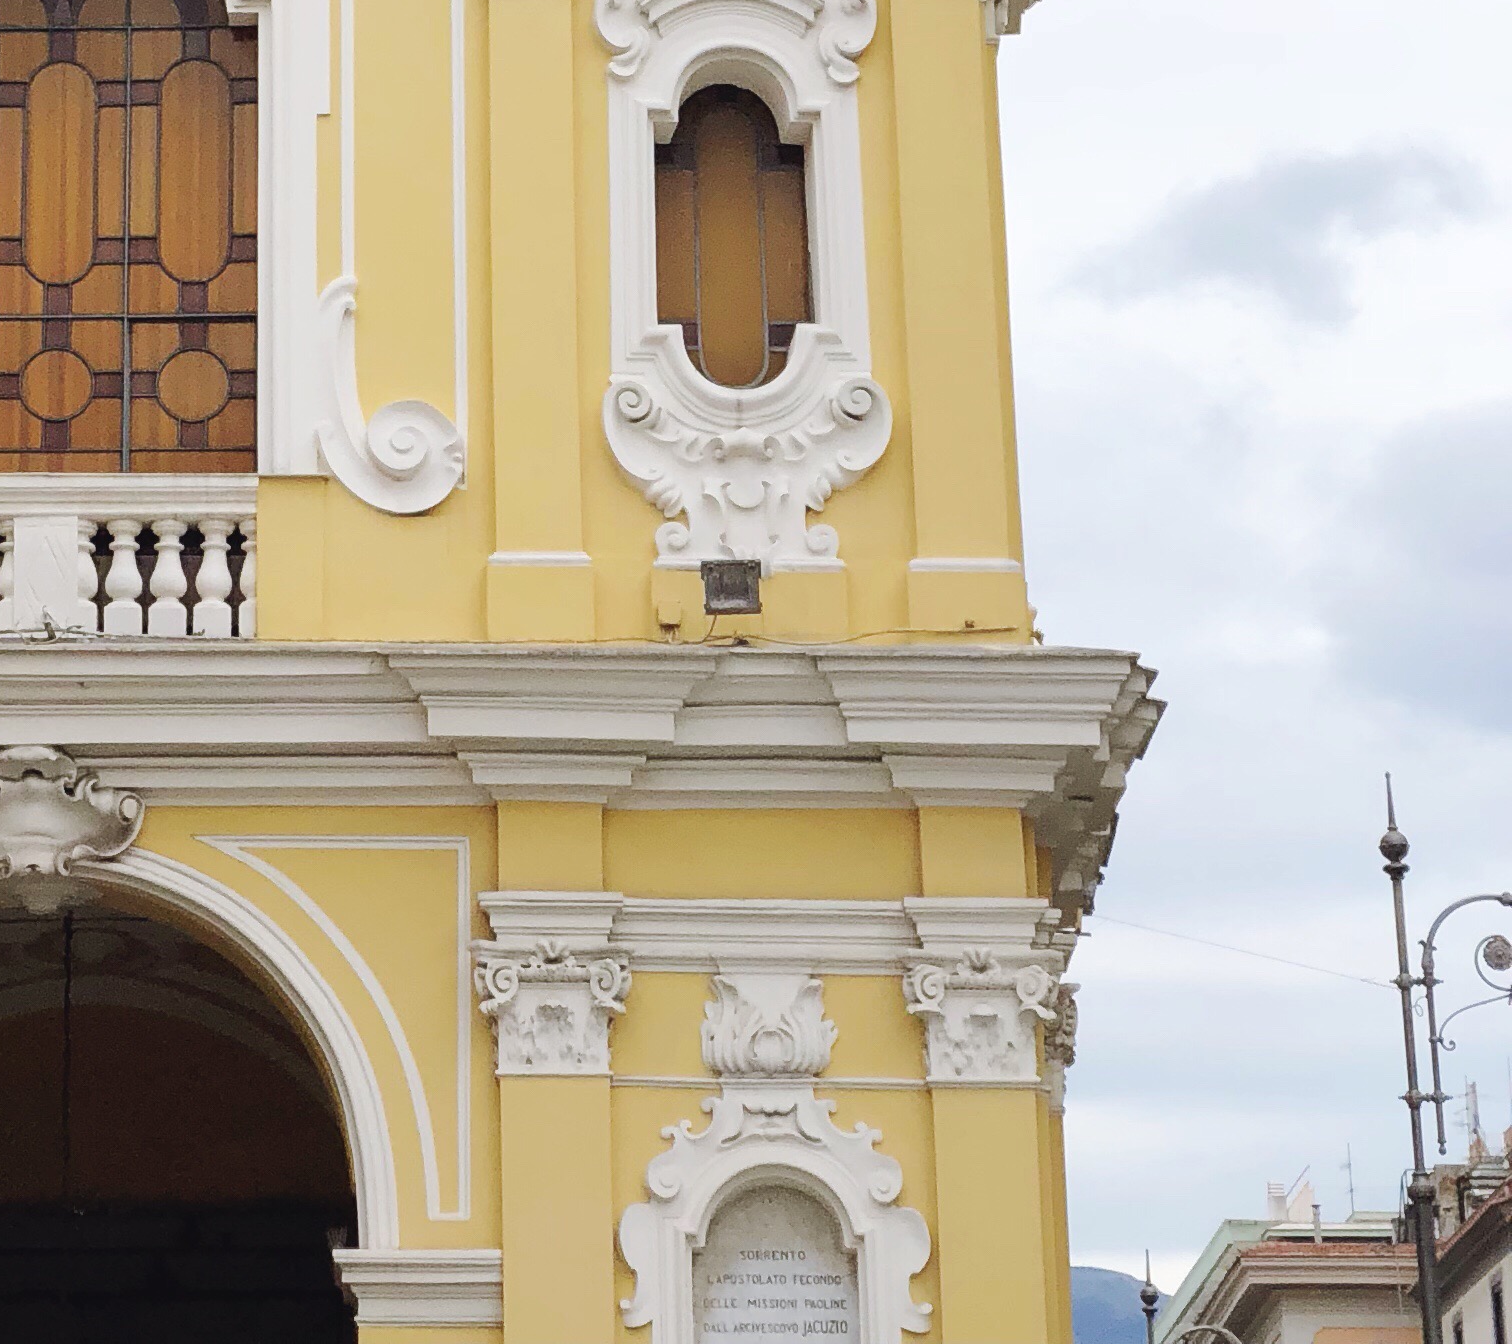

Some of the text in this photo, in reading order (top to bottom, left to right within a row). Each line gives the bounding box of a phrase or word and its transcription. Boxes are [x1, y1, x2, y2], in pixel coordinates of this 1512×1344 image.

[739, 1250, 807, 1261] SORRENTO
[793, 1274, 842, 1285] FECONDO
[703, 1297, 848, 1310] DELLE MISSIONI PAOLINE
[802, 1319, 848, 1337] JACUZIO
